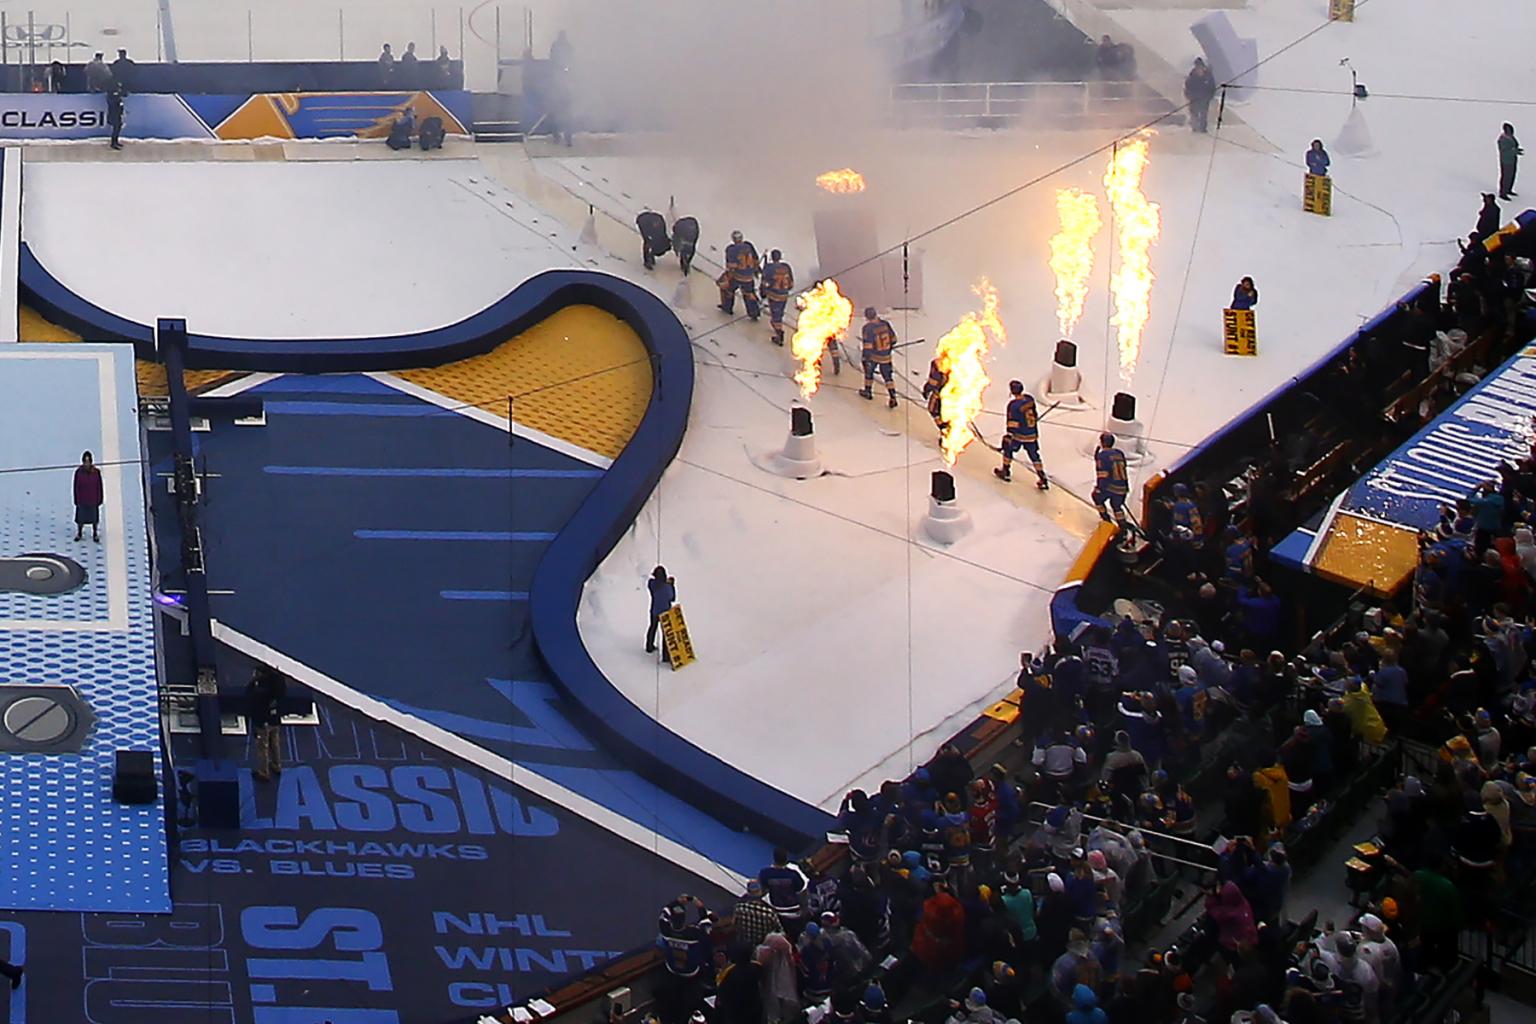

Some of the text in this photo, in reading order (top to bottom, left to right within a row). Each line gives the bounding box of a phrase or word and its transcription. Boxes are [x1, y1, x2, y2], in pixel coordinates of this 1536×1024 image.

[2, 109, 109, 129] CLASSI
[236, 764, 562, 838] LASSIC
[179, 838, 490, 860] BLACKHAWKS
[179, 858, 417, 879] VS. BLUES
[431, 911, 573, 939] NHL
